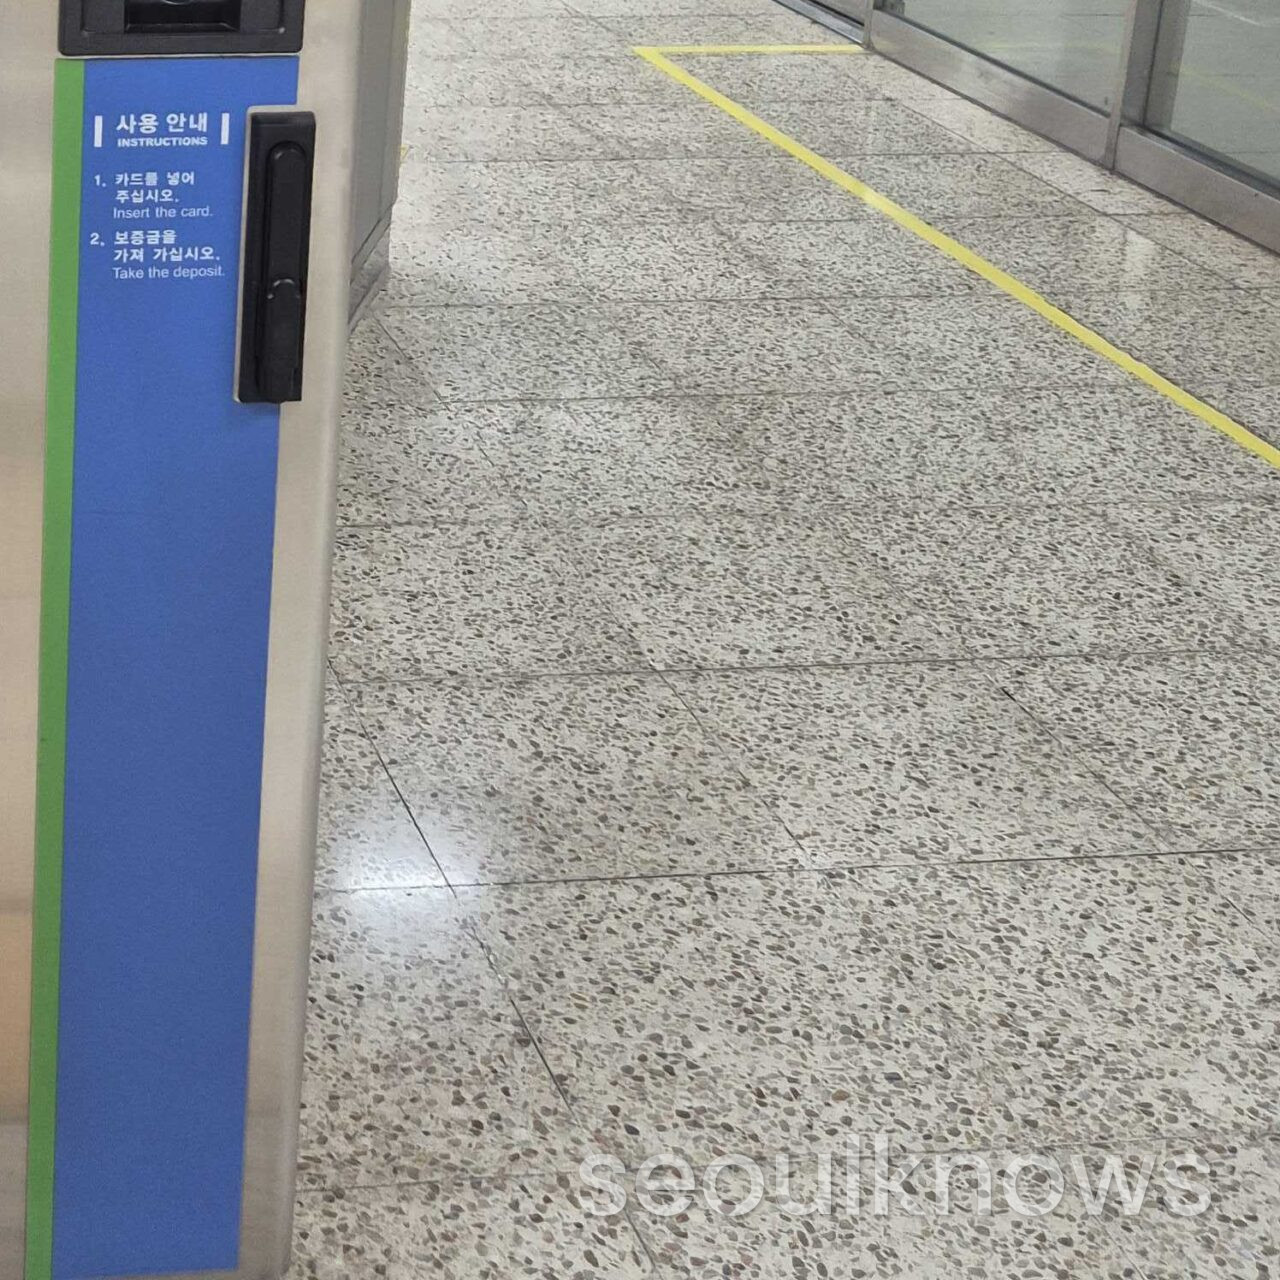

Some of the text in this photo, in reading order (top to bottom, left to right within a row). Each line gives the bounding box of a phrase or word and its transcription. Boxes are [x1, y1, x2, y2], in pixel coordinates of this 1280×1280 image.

[116, 112, 208, 133] 사용 안내
[117, 136, 208, 148] INSTRUCTIONS
[94, 172, 195, 187] 1. 카드를 넣어
[115, 189, 180, 204] 주십시오.
[112, 204, 214, 219] Insert the card.
[90, 230, 177, 246] 2. 보증금을
[113, 246, 221, 263] 가져 가십시오.
[112, 263, 226, 281] Take the deposit.
